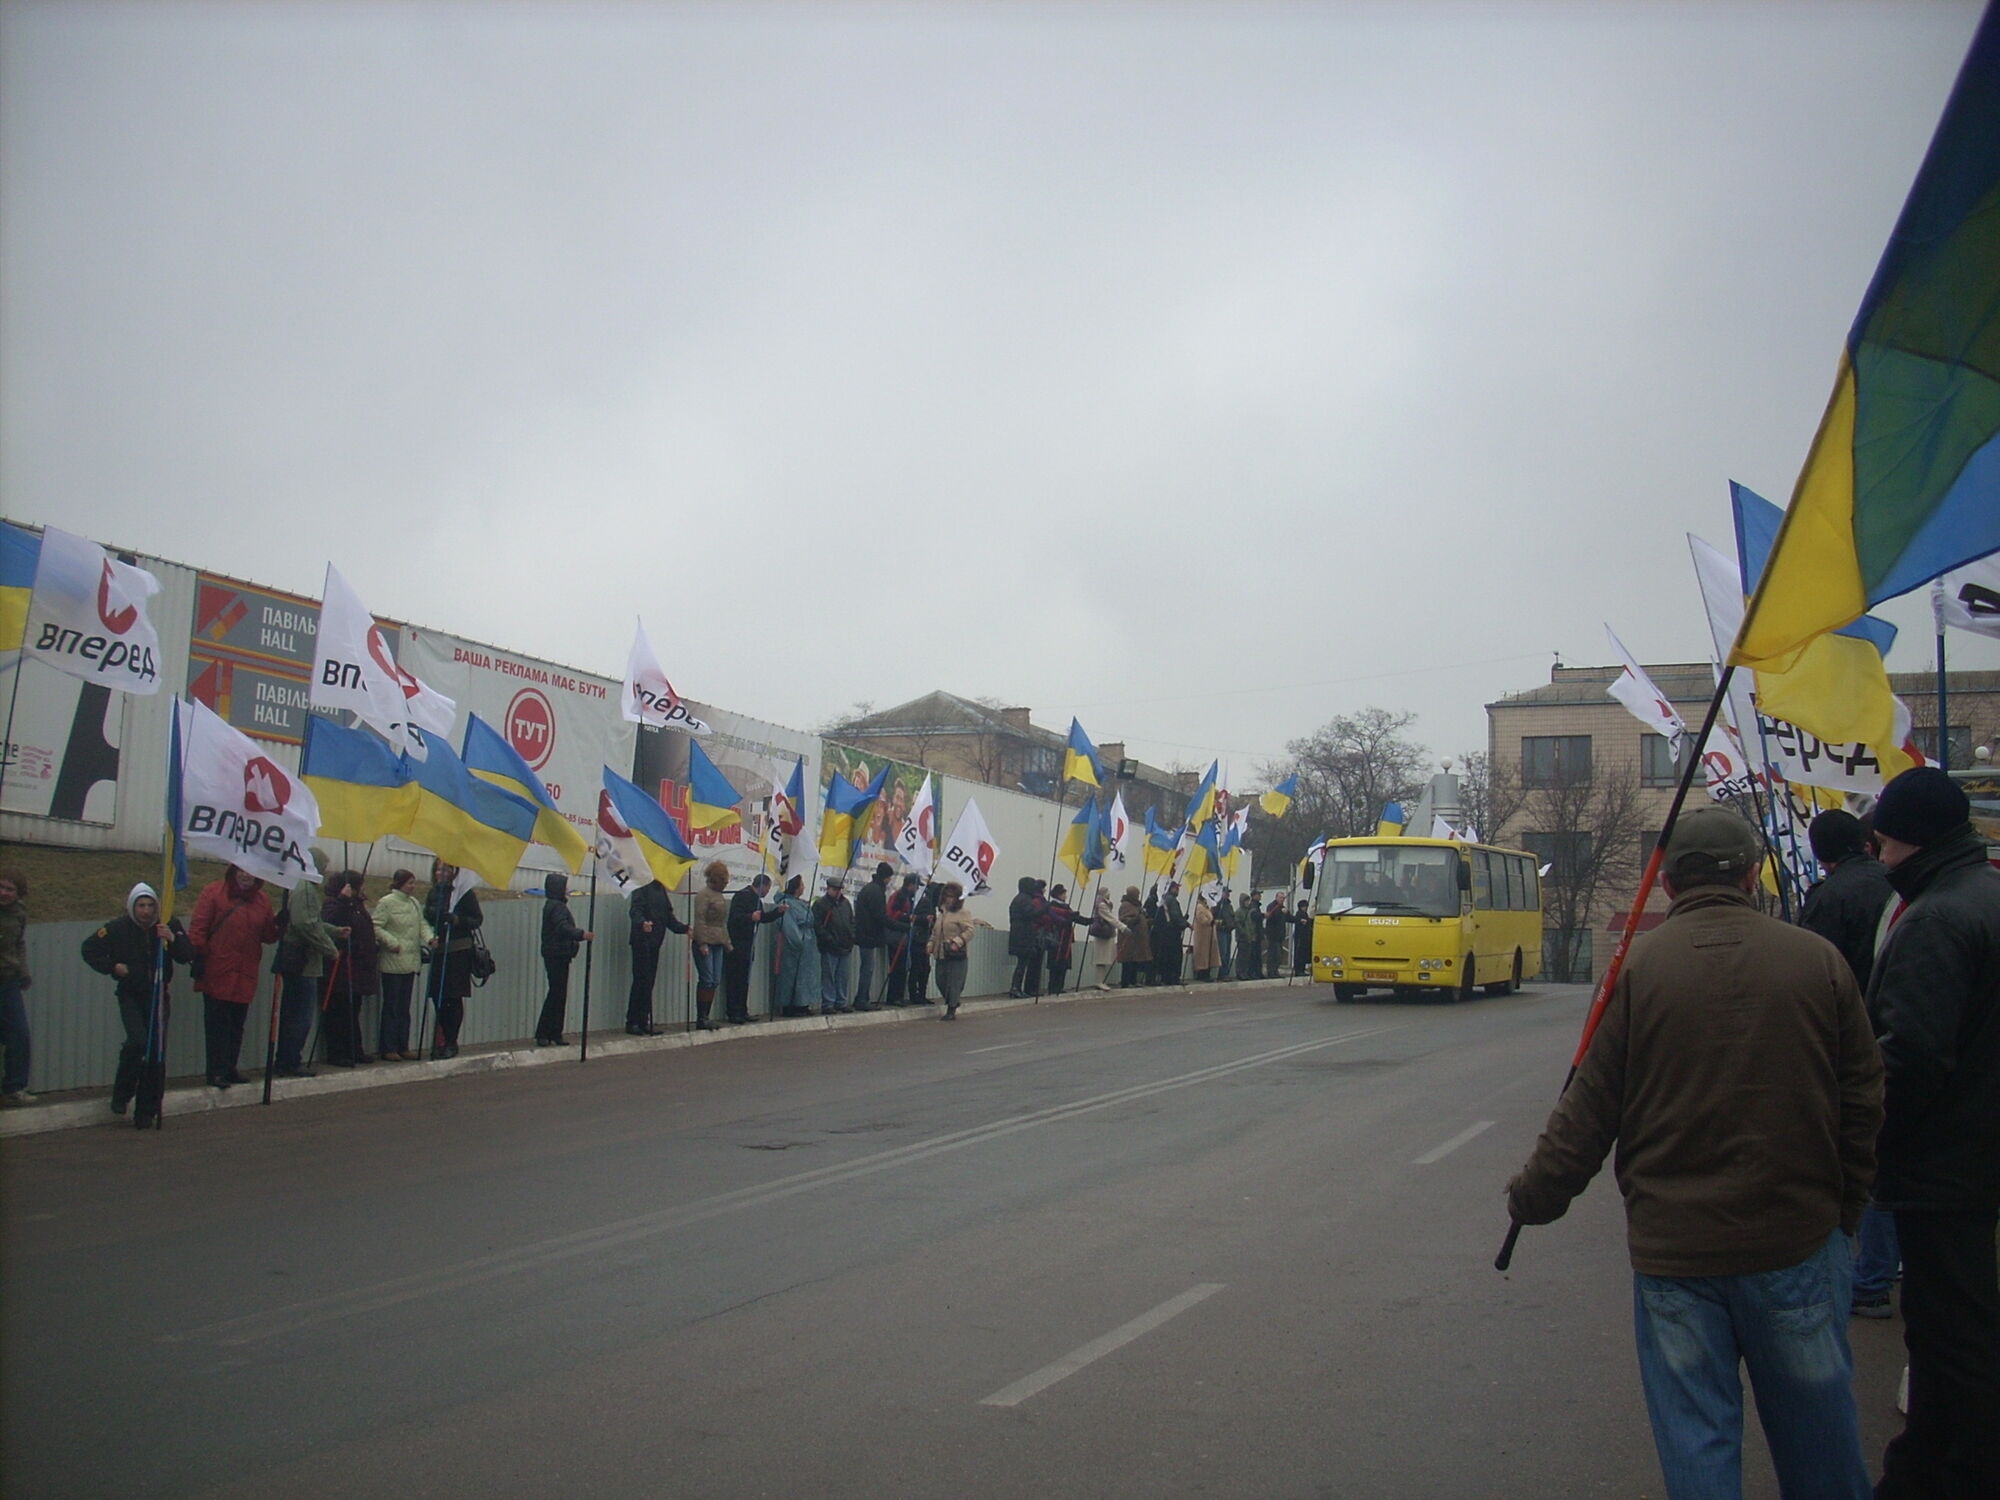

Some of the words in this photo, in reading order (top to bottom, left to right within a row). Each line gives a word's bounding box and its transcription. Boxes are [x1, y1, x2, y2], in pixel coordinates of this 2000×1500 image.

[261, 628, 297, 652] HALL
[454, 648, 491, 669] ВАША
[495, 658, 549, 685] РЕКЛАМА
[552, 674, 576, 692] МАЄ
[579, 682, 606, 700] БУТИ
[254, 704, 290, 728] HALL
[515, 718, 547, 743] ТУТ
[1368, 918, 1400, 926] ISUZU
